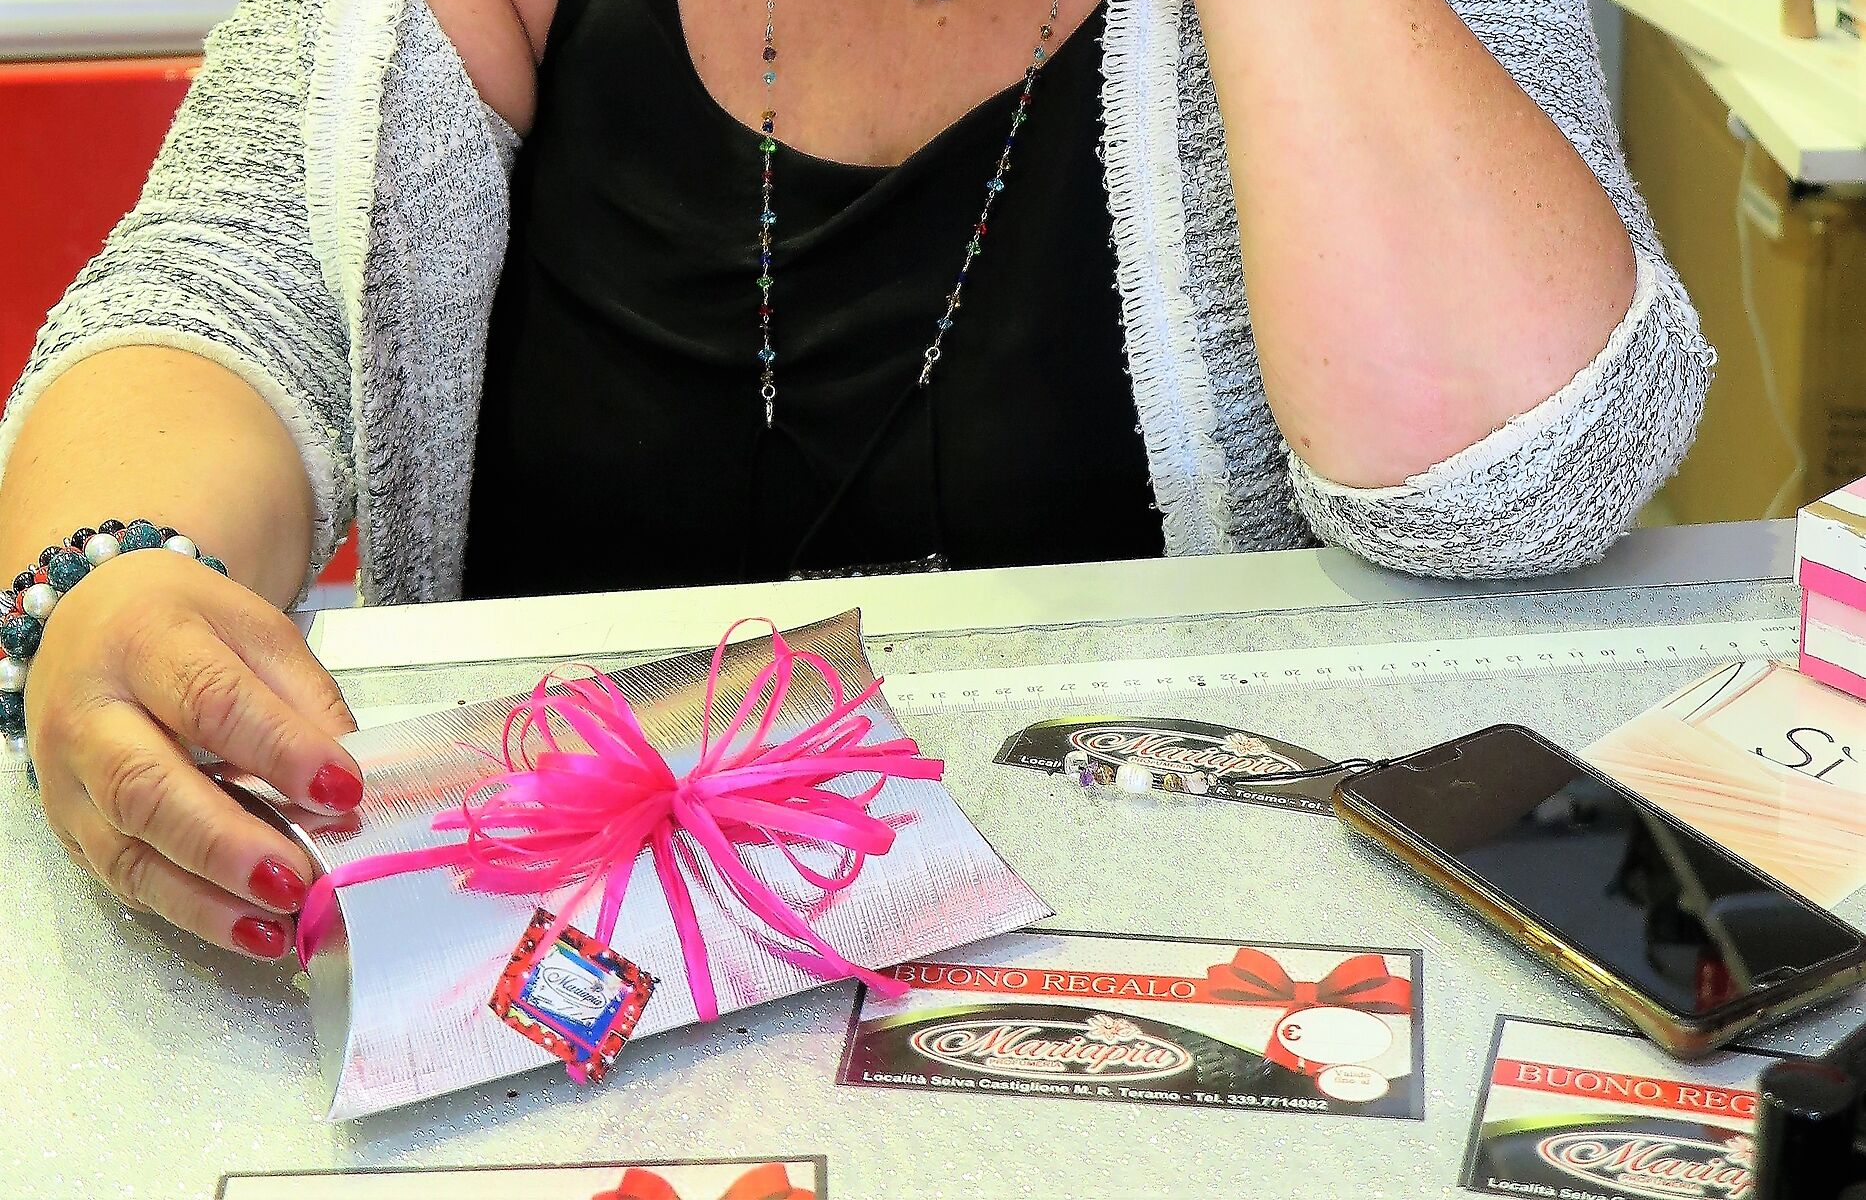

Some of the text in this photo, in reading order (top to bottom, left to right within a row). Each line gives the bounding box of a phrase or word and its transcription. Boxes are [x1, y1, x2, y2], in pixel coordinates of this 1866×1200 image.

[1699, 643, 1708, 652] 7
[1729, 641, 1739, 649] 6
[1760, 639, 1769, 648] 5
[1600, 649, 1616, 658] 10
[1636, 647, 1645, 655] 9
[1475, 657, 1492, 665] 14
[1506, 655, 1523, 663] 13
[1537, 653, 1554, 661] 12
[1381, 663, 1398, 671] 17
[1411, 661, 1428, 669] 16
[1443, 659, 1459, 667] 15
[1284, 669, 1302, 677] 20
[1316, 667, 1333, 675] 19
[1348, 665, 1366, 673] 18
[1187, 675, 1205, 683] 23
[1220, 673, 1238, 681] 22
[1252, 671, 1270, 679] 21
[1091, 681, 1110, 689] 26
[1123, 679, 1142, 687] 25
[1156, 677, 1174, 685] 24
[1027, 685, 1045, 693] 28
[1060, 683, 1077, 691] 27
[931, 690, 947, 700] 31
[962, 689, 980, 698] 30
[995, 687, 1012, 696] 29
[898, 693, 915, 702] 32
[1088, 734, 1290, 774] Mariapia
[1216, 786, 1230, 796] R.
[1236, 789, 1286, 804] Teramo
[1300, 800, 1323, 811] Tel.
[894, 964, 1196, 999] BUONO REGALO
[933, 1025, 1174, 1074] Mariapia
[989, 1057, 1063, 1069] PROFUMERIA
[862, 1071, 927, 1086] Località
[930, 1075, 976, 1088] Selva
[978, 1078, 1070, 1095] Castiglione
[1073, 1084, 1093, 1095] M.
[1097, 1086, 1114, 1097] R.
[1118, 1087, 1181, 1101] Teramo
[1193, 1092, 1224, 1105] Tel.
[1227, 1094, 1328, 1111] 339.7714082
[1516, 1064, 1756, 1116] BUONO REG
[1487, 1177, 1556, 1197] Località
